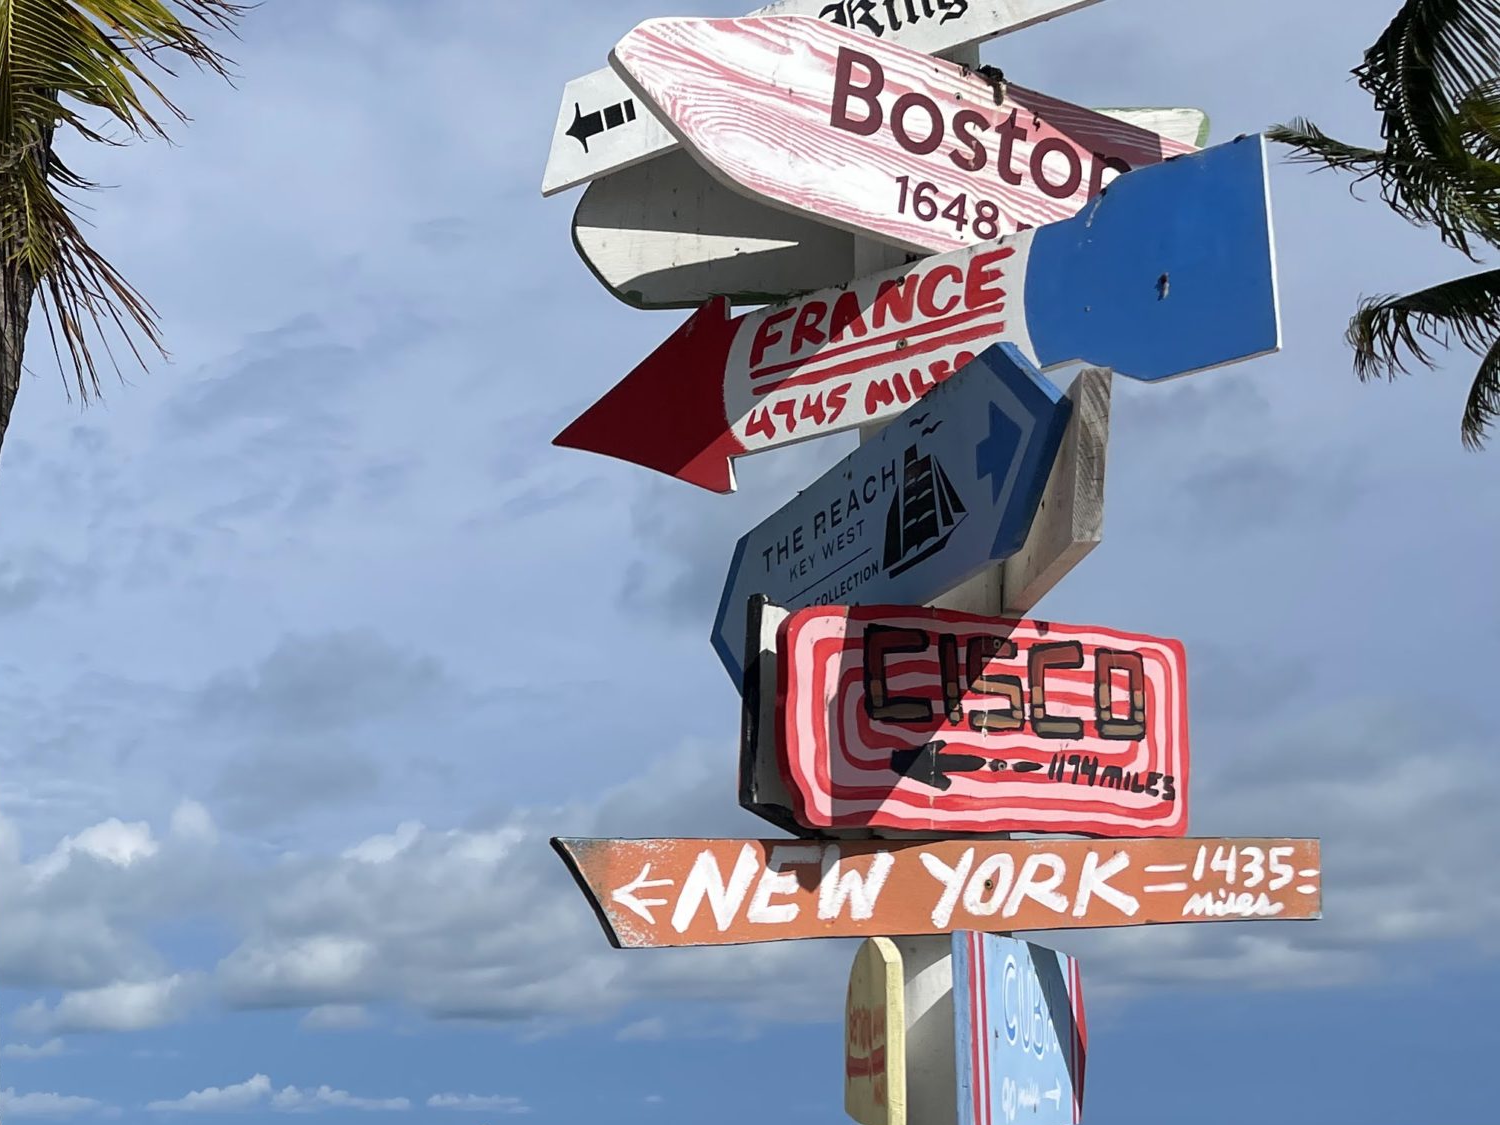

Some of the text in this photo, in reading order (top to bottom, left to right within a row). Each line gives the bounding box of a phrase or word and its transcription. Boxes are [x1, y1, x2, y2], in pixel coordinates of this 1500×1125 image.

[895, 175, 999, 240] 1648
[750, 247, 1016, 368] FRANCE
[745, 382, 852, 440] 4745
[762, 459, 896, 572] THE REACH
[790, 519, 865, 582] KEY WEST
[864, 623, 1146, 741] CISCO
[1100, 765, 1176, 801] MILES
[671, 842, 895, 934] NEW
[919, 847, 1141, 930] YORK
[1192, 845, 1294, 891] 1435
